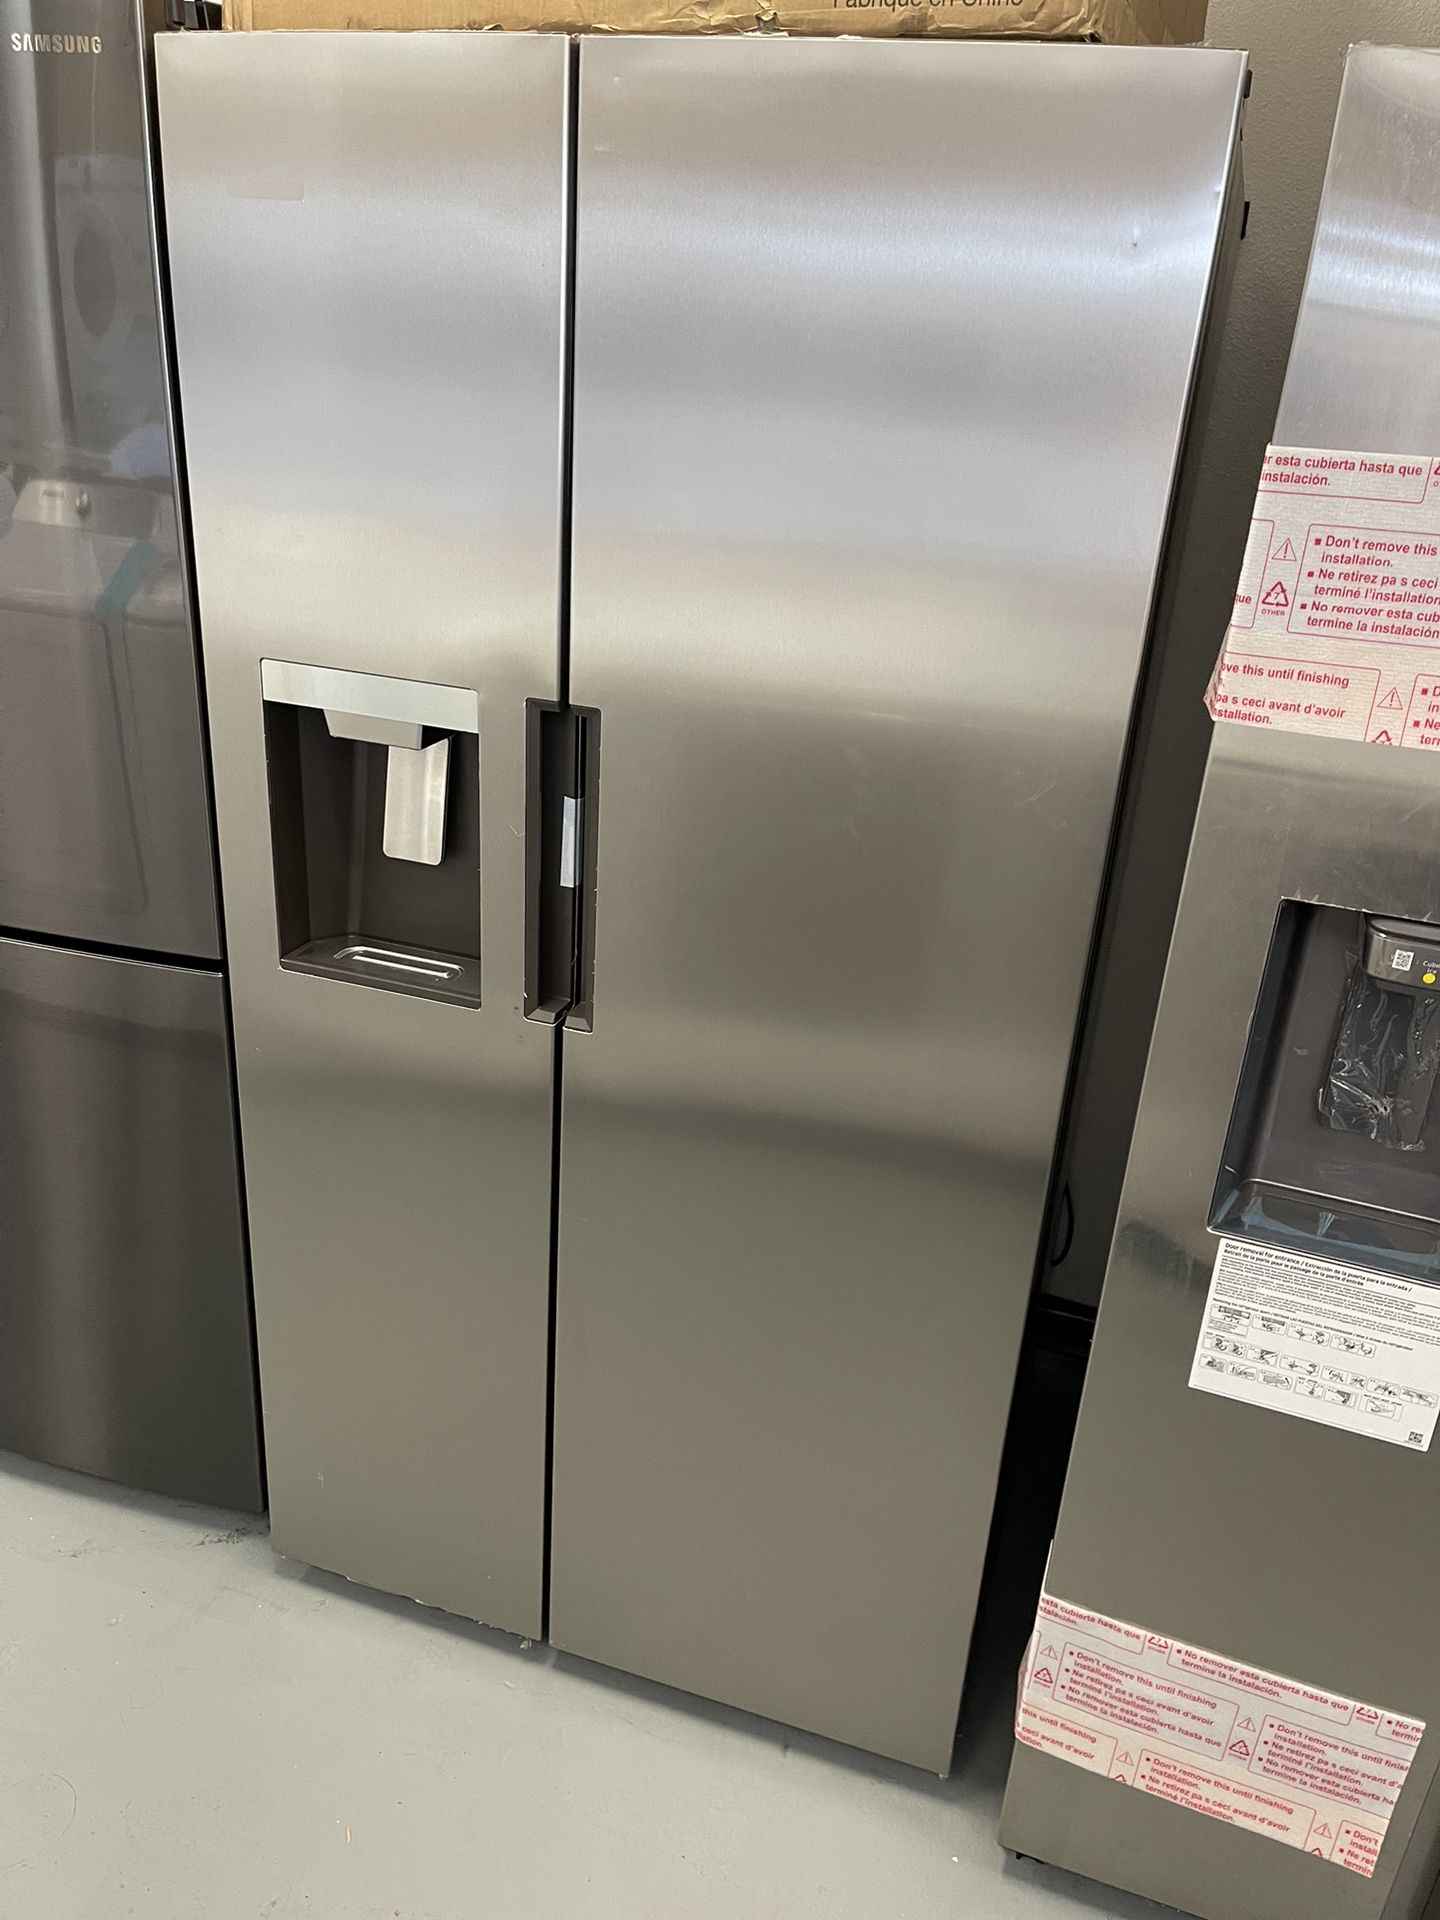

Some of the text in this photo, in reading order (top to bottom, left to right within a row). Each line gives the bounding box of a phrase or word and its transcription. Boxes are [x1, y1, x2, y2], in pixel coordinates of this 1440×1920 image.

[11, 32, 103, 54] SAMSUNG
[1262, 470, 1331, 486] instalación.
[1275, 455, 1301, 467] esta
[1304, 457, 1356, 471] cubierta
[1359, 460, 1394, 474] hasta
[1398, 465, 1423, 478] que
[1325, 535, 1438, 556] Don't remove this
[1321, 552, 1393, 567] installation.
[1318, 568, 1439, 589] Ne retirez pa s ceci
[1314, 585, 1361, 599] terminé
[1261, 608, 1285, 617] OTHER
[1311, 601, 1328, 612] No
[1331, 604, 1383, 618] remover
[1386, 608, 1413, 620] esta
[1307, 616, 1353, 630] termine
[1356, 620, 1367, 632] la
[1242, 664, 1264, 677] this
[1267, 667, 1294, 680] until
[1296, 671, 1350, 689] finishing
[1231, 696, 1239, 705] s
[1241, 697, 1266, 708] ceci
[1268, 700, 1301, 714] avant
[1303, 703, 1346, 719] d'avoir
[1060, 1607, 1096, 1622] cubierta
[1097, 1618, 1122, 1633] hasta
[1123, 1629, 1141, 1640] que
[1073, 1661, 1124, 1686] installation.
[1076, 1651, 1217, 1710] Don't remove this until finishing
[1181, 1658, 1282, 1699] termine la instalación.
[1184, 1649, 1349, 1711] No remover esta cubierta hasta que
[1072, 1669, 1084, 1679] Ne
[1086, 1674, 1113, 1692] retirez
[1115, 1687, 1126, 1697] pa
[1135, 1694, 1154, 1705] ceci
[1156, 1702, 1181, 1715] avant
[1182, 1710, 1215, 1726] d'avoir
[1022, 1707, 1097, 1744] this until finishing
[1067, 1686, 1222, 1748] No remover esta cubierta hasta que
[1394, 1720, 1409, 1731] No
[1021, 1725, 1096, 1760] ceci avant d'avoir
[1273, 1733, 1327, 1757] installation.
[1276, 1724, 1303, 1738] Don't
[1304, 1734, 1339, 1751] remove
[1341, 1746, 1359, 1758] this
[1361, 1753, 1383, 1766] until
[1271, 1741, 1285, 1751] Ne
[1286, 1747, 1316, 1761] retirez
[1317, 1758, 1329, 1768] pa
[1339, 1765, 1359, 1776] ceci
[1360, 1771, 1386, 1785] avant
[1150, 1766, 1201, 1790] installation.
[1152, 1757, 1294, 1815] Don't remove this until finishing
[1262, 1765, 1362, 1805] termine la instalación.
[1265, 1758, 1394, 1806] No remover esta cubierta ha
[1352, 1830, 1379, 1846] Don't
